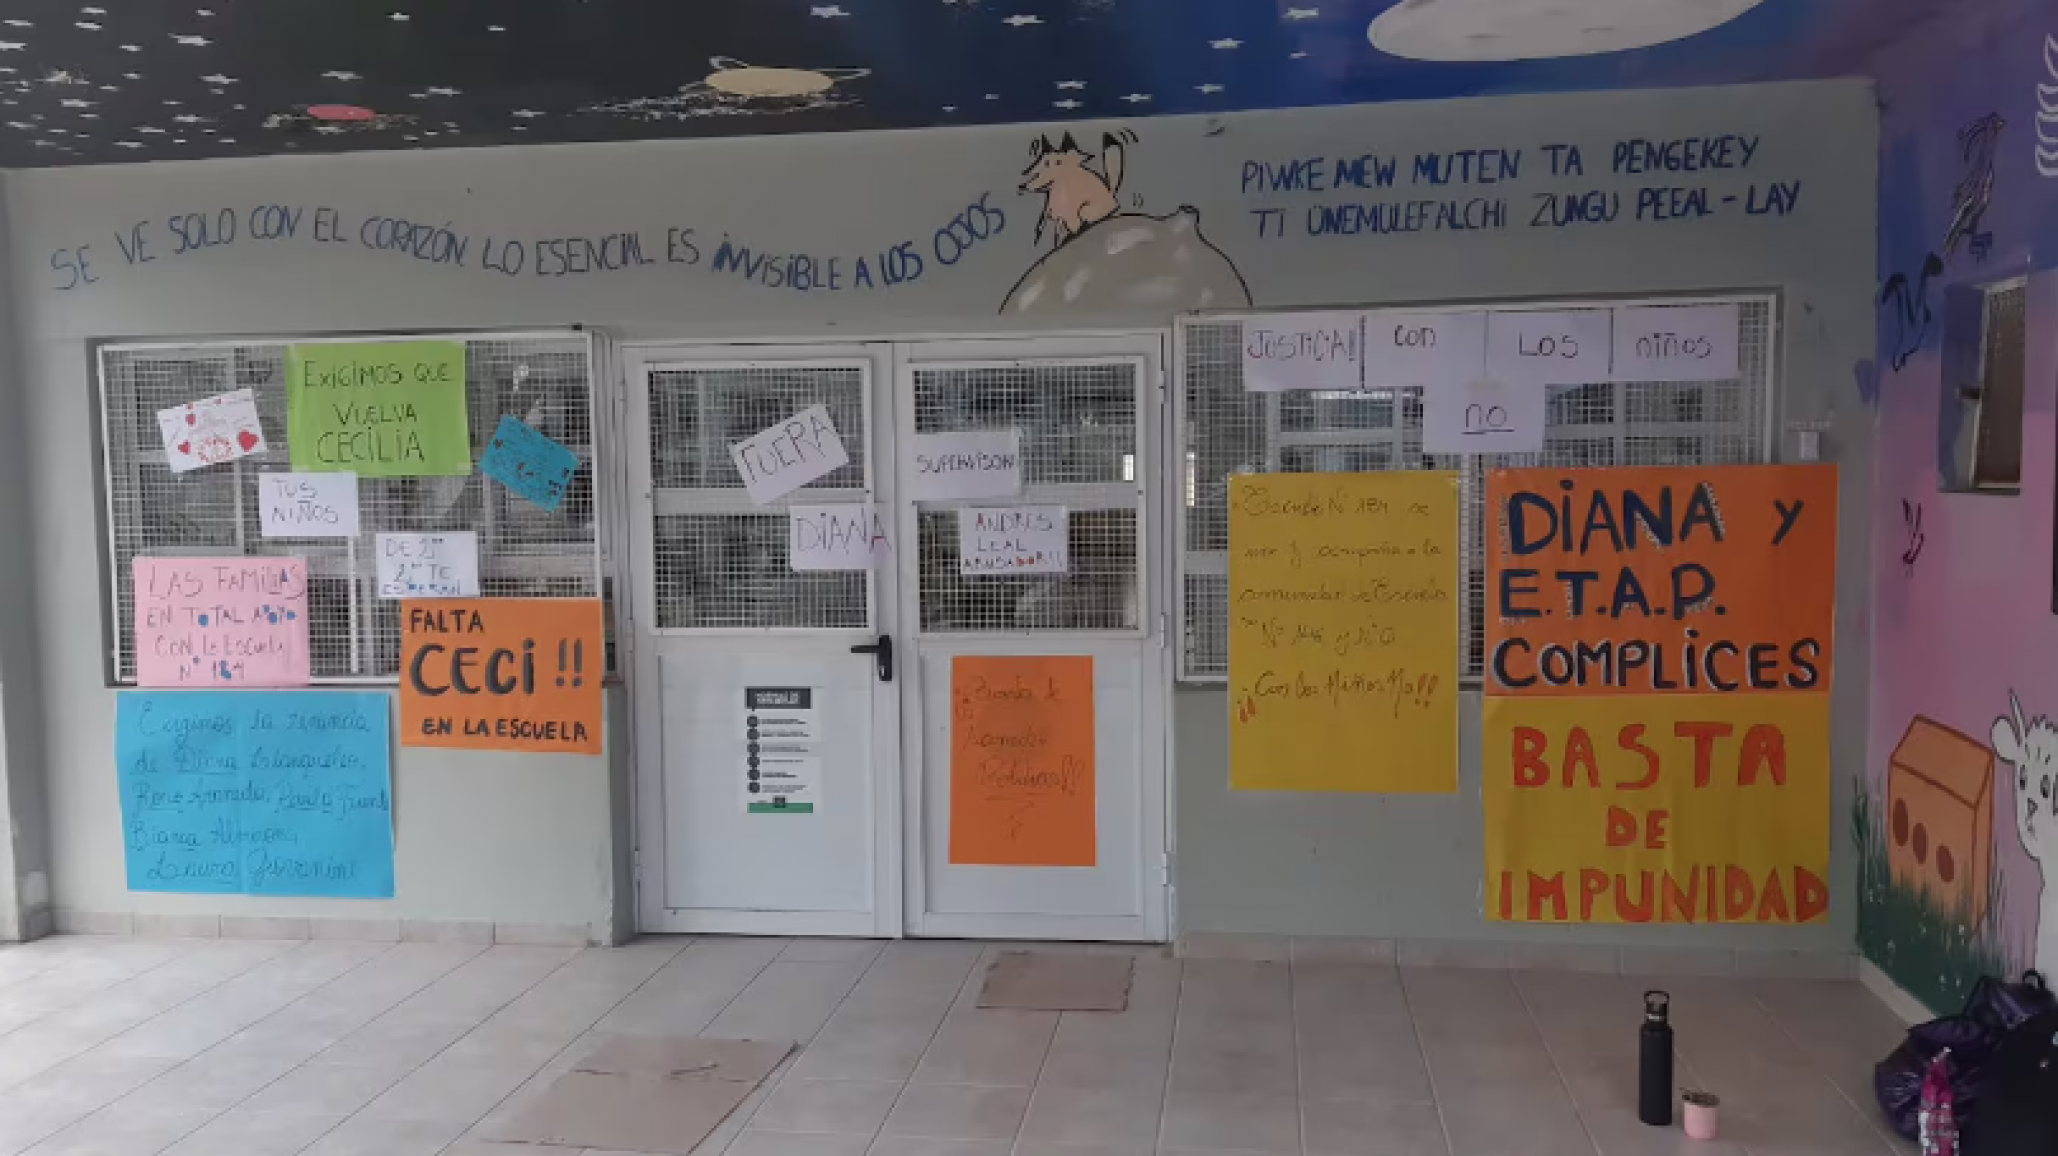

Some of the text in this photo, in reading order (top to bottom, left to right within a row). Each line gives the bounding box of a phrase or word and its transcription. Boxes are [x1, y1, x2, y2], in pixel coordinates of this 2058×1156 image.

[1241, 135, 1759, 194] PIWKE MEW MUTEN TA PENGEKEY
[1529, 191, 1620, 227] ZUNGU
[1636, 187, 1709, 221] PEEAL
[1746, 180, 1802, 218] LAY
[50, 244, 99, 290] SE
[114, 220, 157, 265] VE
[169, 207, 237, 255] SOLO
[248, 205, 302, 240] CON
[314, 207, 348, 244] EL
[360, 215, 469, 267] CORAZÓN
[483, 237, 523, 275] LO
[668, 227, 700, 265] ES
[854, 259, 874, 290] A
[879, 241, 924, 286] LOS
[934, 191, 1005, 265] OJOS
[1518, 333, 1579, 358] LOS
[413, 362, 450, 383] QUE
[332, 402, 418, 426] VUELVA
[740, 415, 833, 484] FUERA
[978, 537, 1027, 553] LEAL
[149, 563, 204, 600] LAS
[147, 604, 173, 628] EN
[410, 609, 484, 634] FALTA
[423, 717, 588, 742] EN LA ESCUELA
[1512, 722, 1787, 790] BASTA
[1607, 806, 1669, 849] DE
[1500, 864, 1829, 923] IMPUNIDAD
